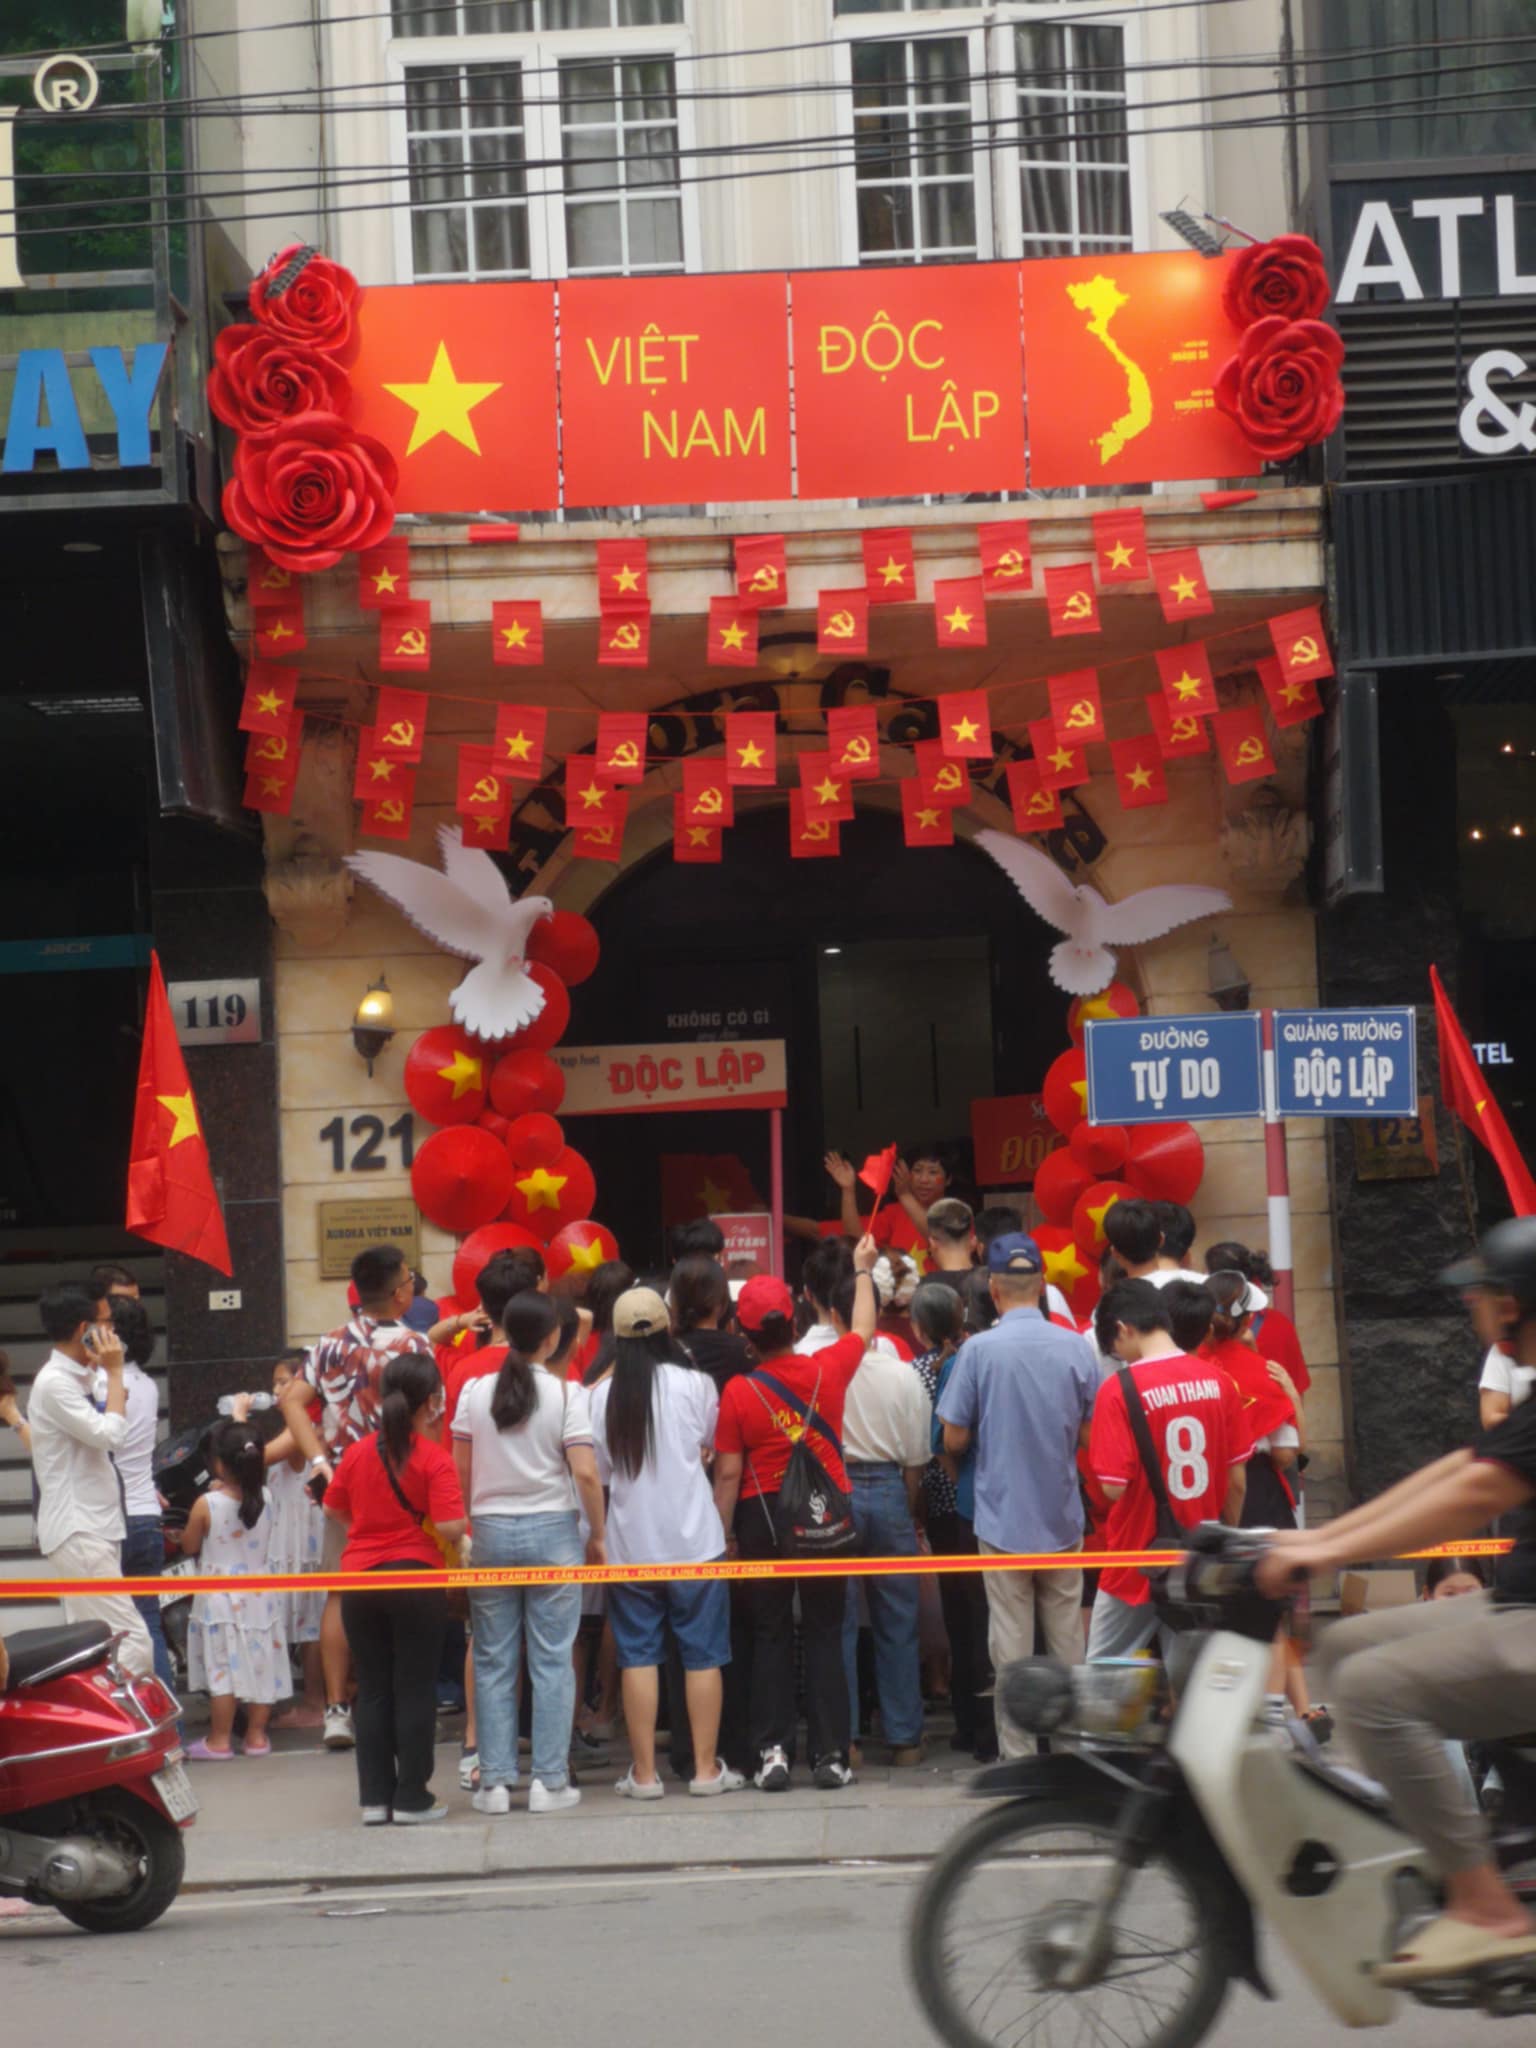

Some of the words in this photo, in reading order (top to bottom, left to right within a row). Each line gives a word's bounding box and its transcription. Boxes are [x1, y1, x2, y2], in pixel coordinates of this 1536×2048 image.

[585, 322, 700, 397] VIỆT
[817, 309, 945, 383] ĐỘC
[643, 406, 766, 459] NAM
[906, 378, 1001, 453] LẬP
[184, 993, 248, 1030] 119
[1283, 1016, 1339, 1043] QUẢNG
[1341, 1017, 1403, 1042] TRƯỜNG
[1139, 1026, 1210, 1051] ĐƯỜNG
[1471, 1042, 1515, 1065] TEL
[607, 1053, 684, 1099] ĐỘC
[695, 1047, 766, 1093] LẬP
[1130, 1057, 1171, 1110] TỰ
[1180, 1057, 1221, 1099] DO
[1293, 1047, 1342, 1107] ĐỘC
[1348, 1047, 1394, 1107] LẬP
[319, 1111, 414, 1172] 121
[1177, 1378, 1221, 1404] THANH
[1165, 1415, 1210, 1501] 8
